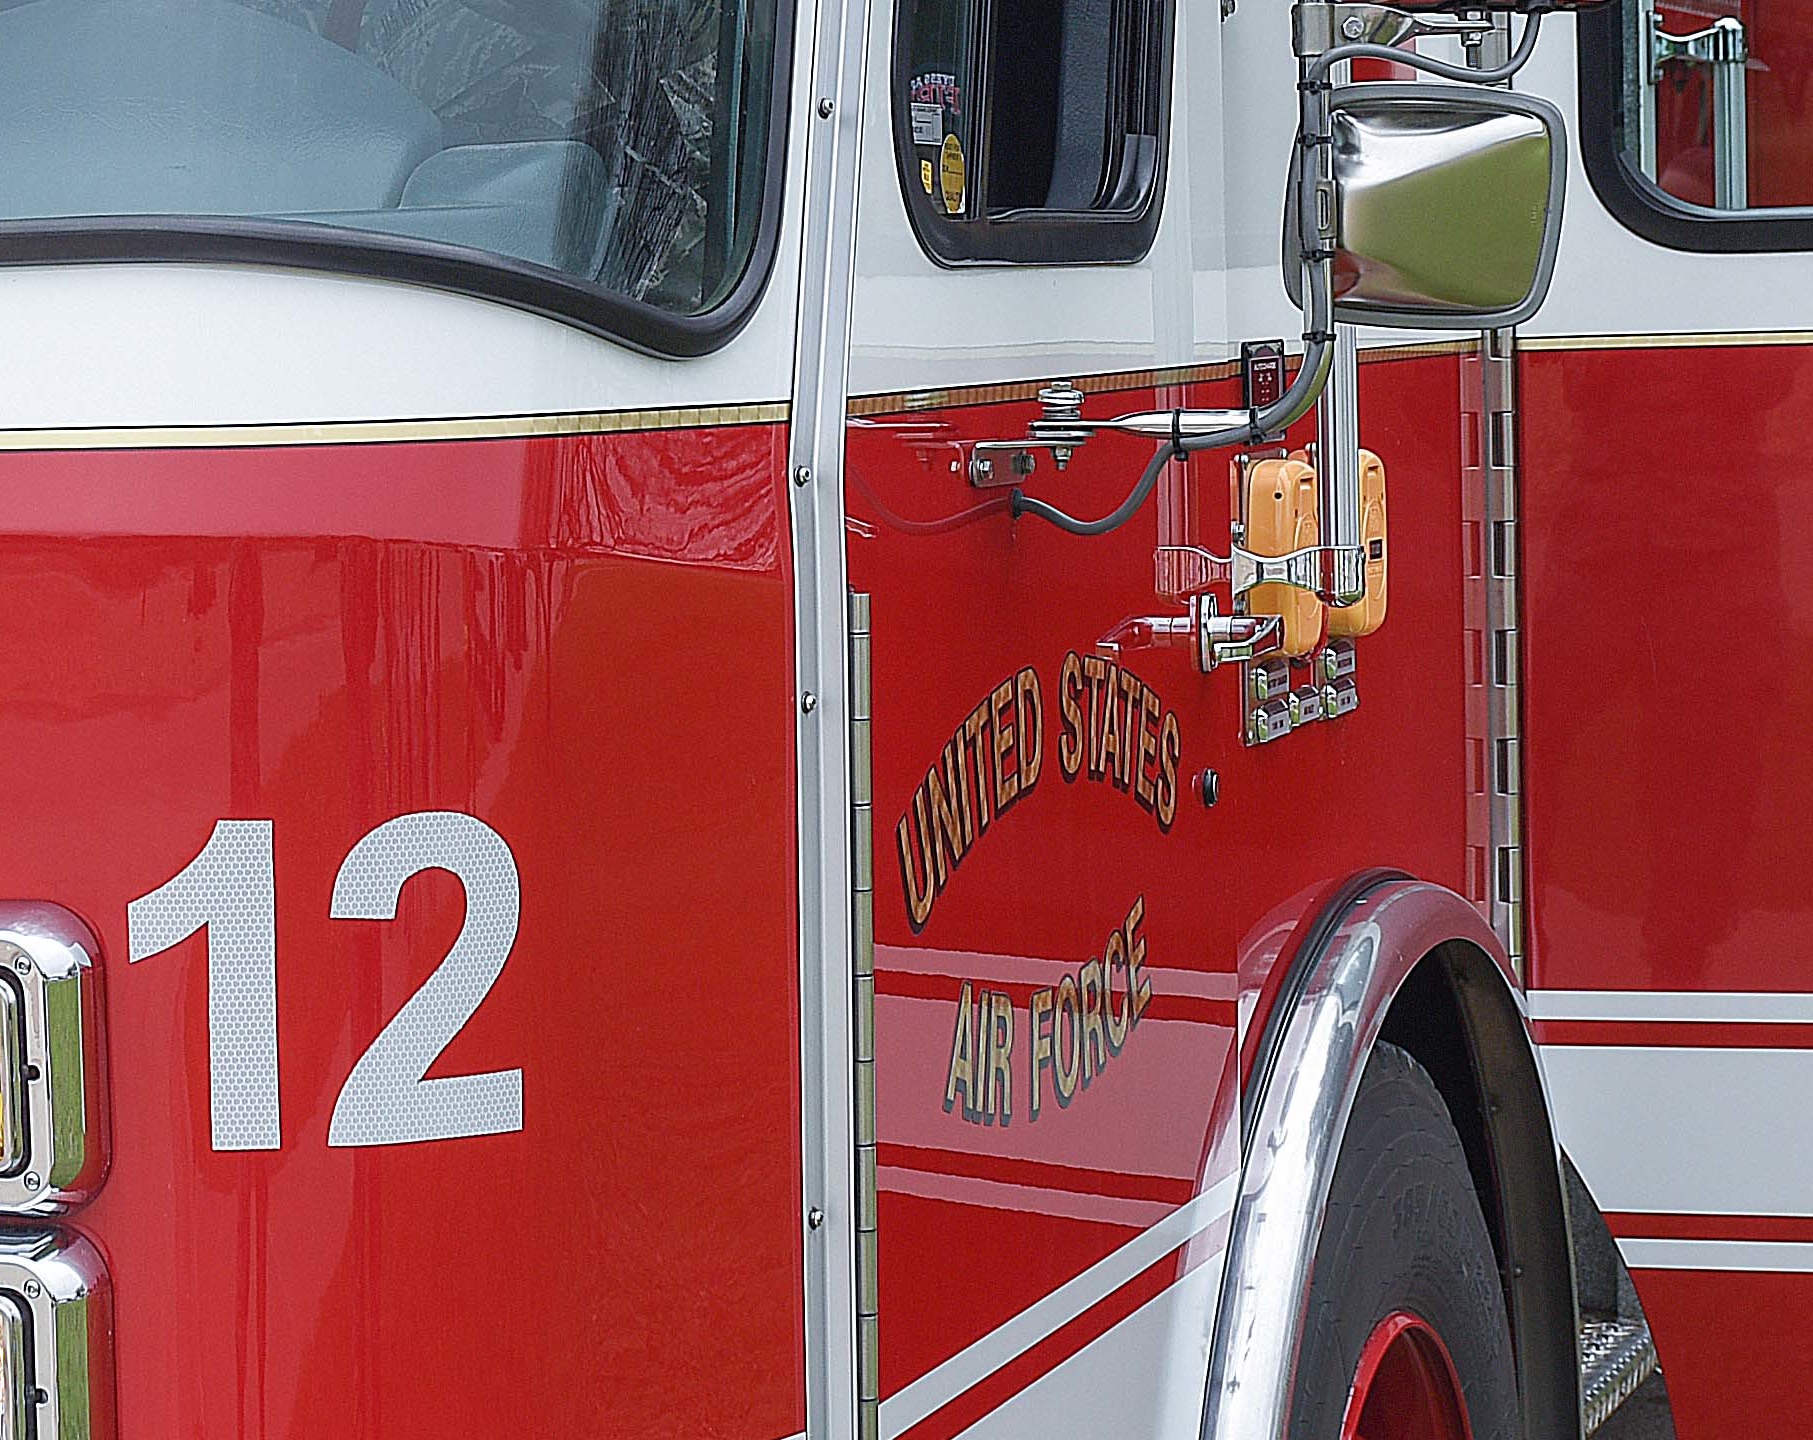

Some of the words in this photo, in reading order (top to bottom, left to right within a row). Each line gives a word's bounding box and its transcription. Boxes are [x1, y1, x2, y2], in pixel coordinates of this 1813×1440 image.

[896, 665, 1043, 934] UNITED
[1057, 650, 1181, 835] STATES
[127, 810, 523, 1151] 12
[941, 979, 1015, 1127] AIR
[1028, 894, 1152, 1122] FORCE
